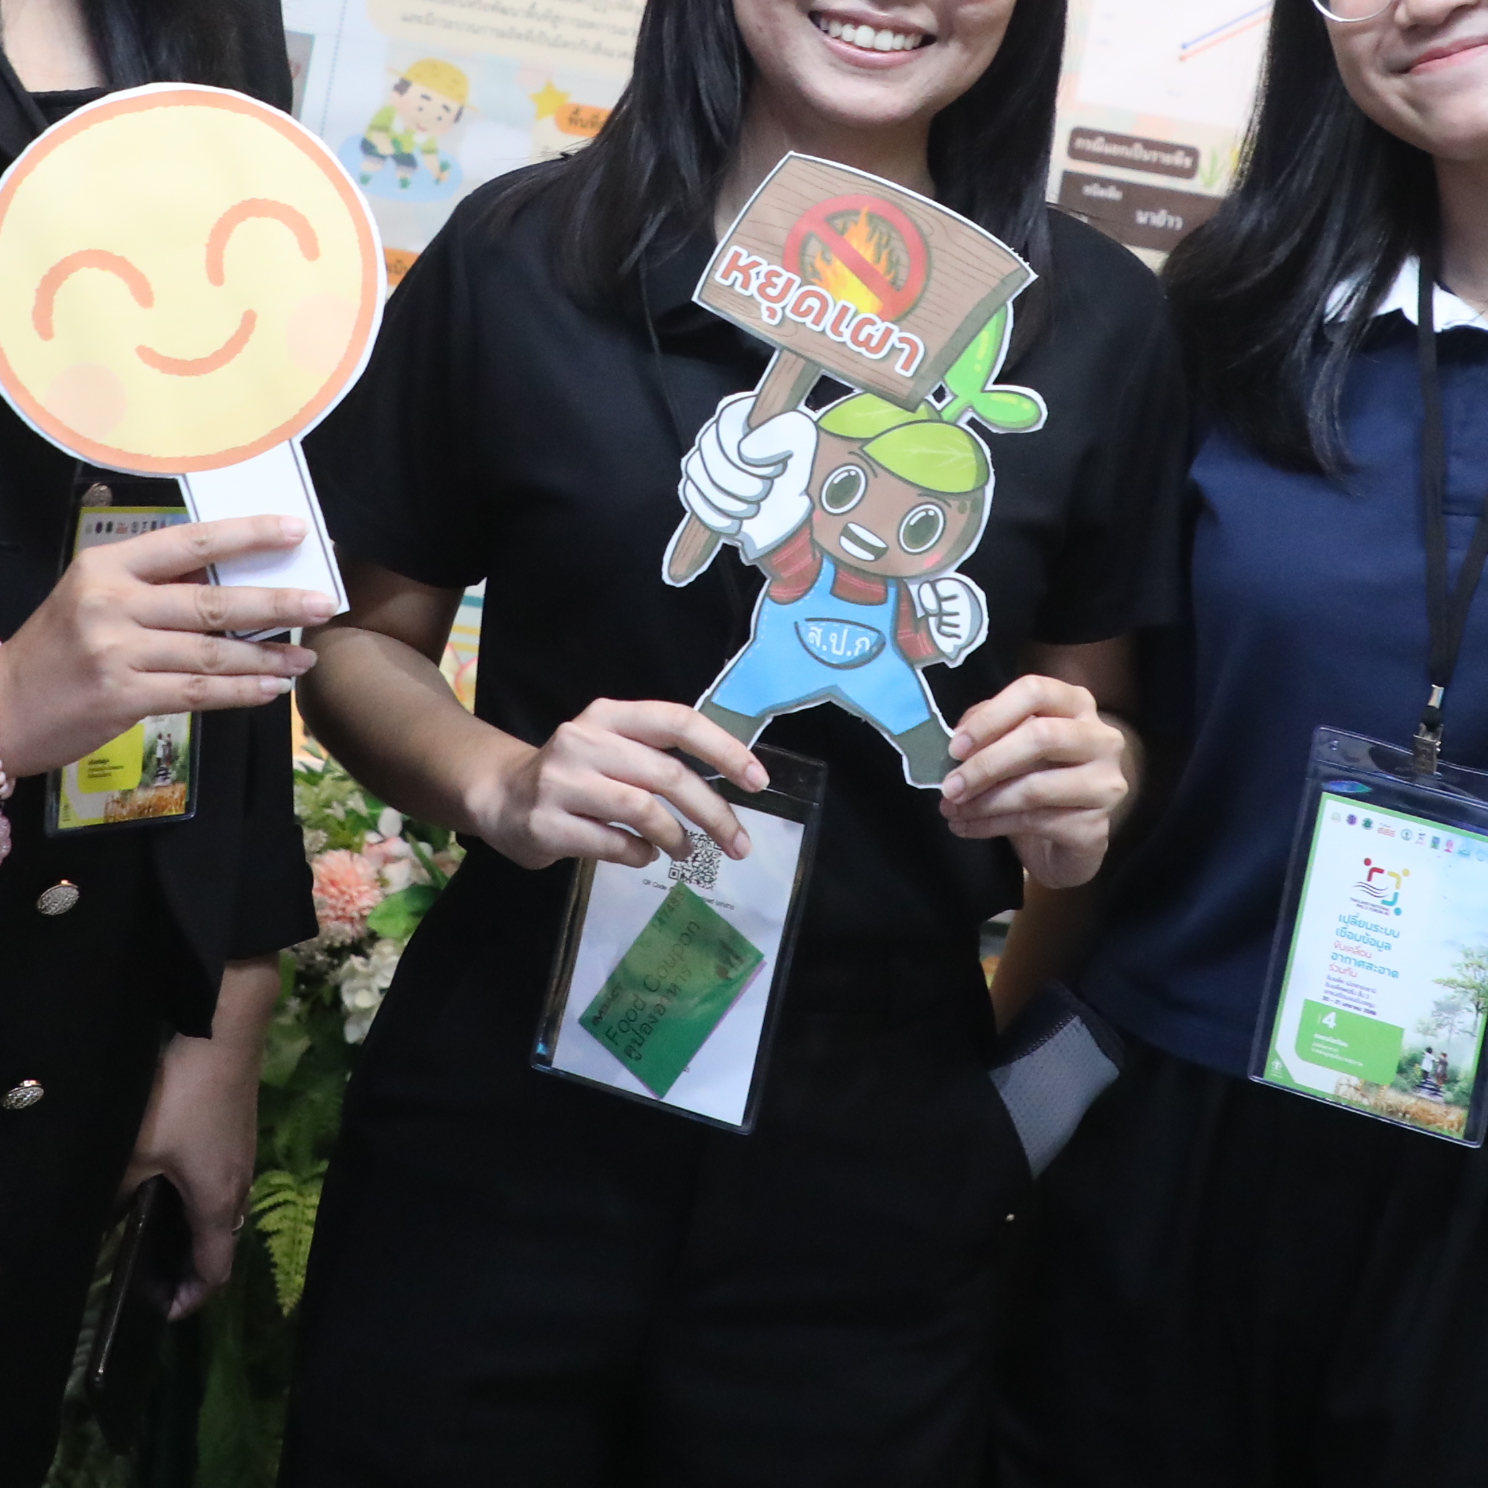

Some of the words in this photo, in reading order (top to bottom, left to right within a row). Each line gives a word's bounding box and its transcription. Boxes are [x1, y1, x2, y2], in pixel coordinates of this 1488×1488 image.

[714, 244, 928, 380] หยุดเผา
[1334, 925, 1392, 953] เชื่อมข้อมูล
[1338, 912, 1401, 939] เปลี่ยนระบบ
[1330, 950, 1400, 979] อากาศสะอาด
[604, 992, 648, 1048] Food
[641, 917, 703, 995] Coupon
[623, 965, 694, 1063] คูปองอาหาร
[1321, 1010, 1338, 1030] 4
